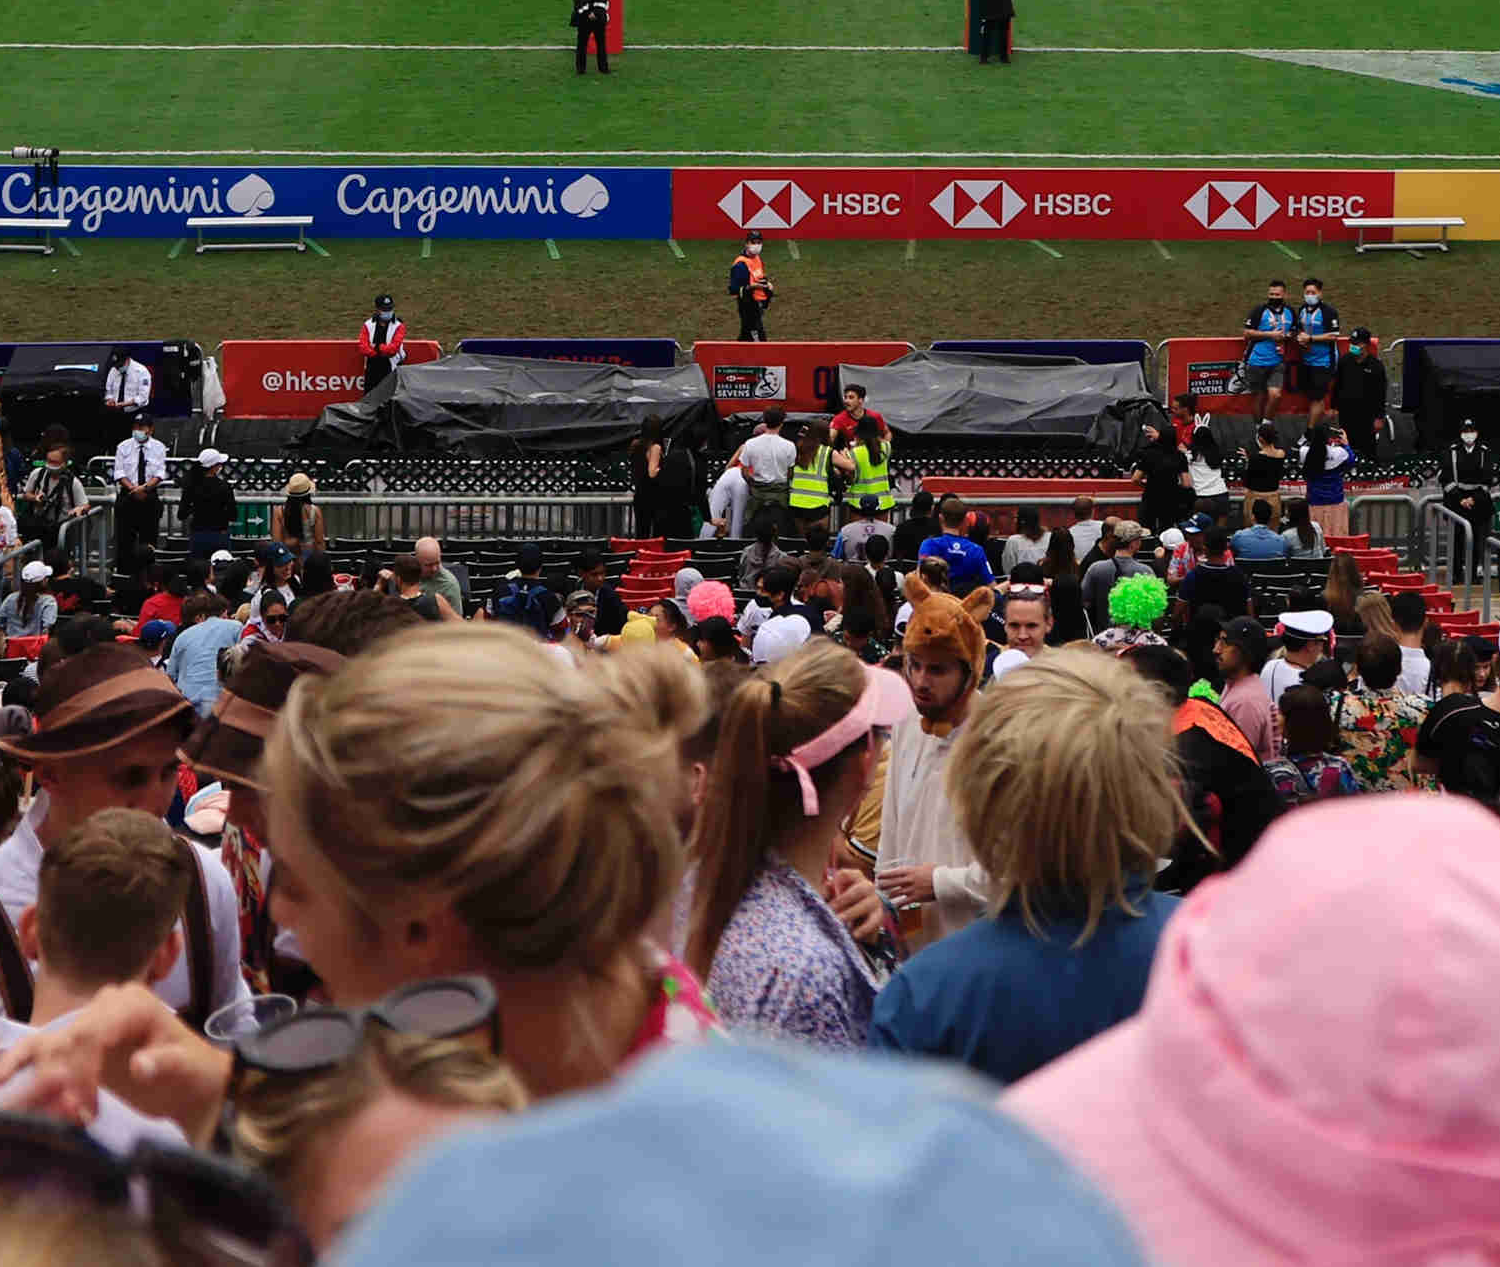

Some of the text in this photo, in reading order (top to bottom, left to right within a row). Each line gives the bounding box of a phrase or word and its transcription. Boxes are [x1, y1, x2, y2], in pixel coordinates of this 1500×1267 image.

[1, 171, 224, 232] Capgemini
[336, 173, 556, 232] Capgemini
[822, 193, 901, 216] HSBC
[1033, 193, 1112, 216] HSBC
[1286, 194, 1364, 218] HSBC
[717, 389, 750, 398] SEVENS
[1191, 386, 1224, 394] SEVENS
